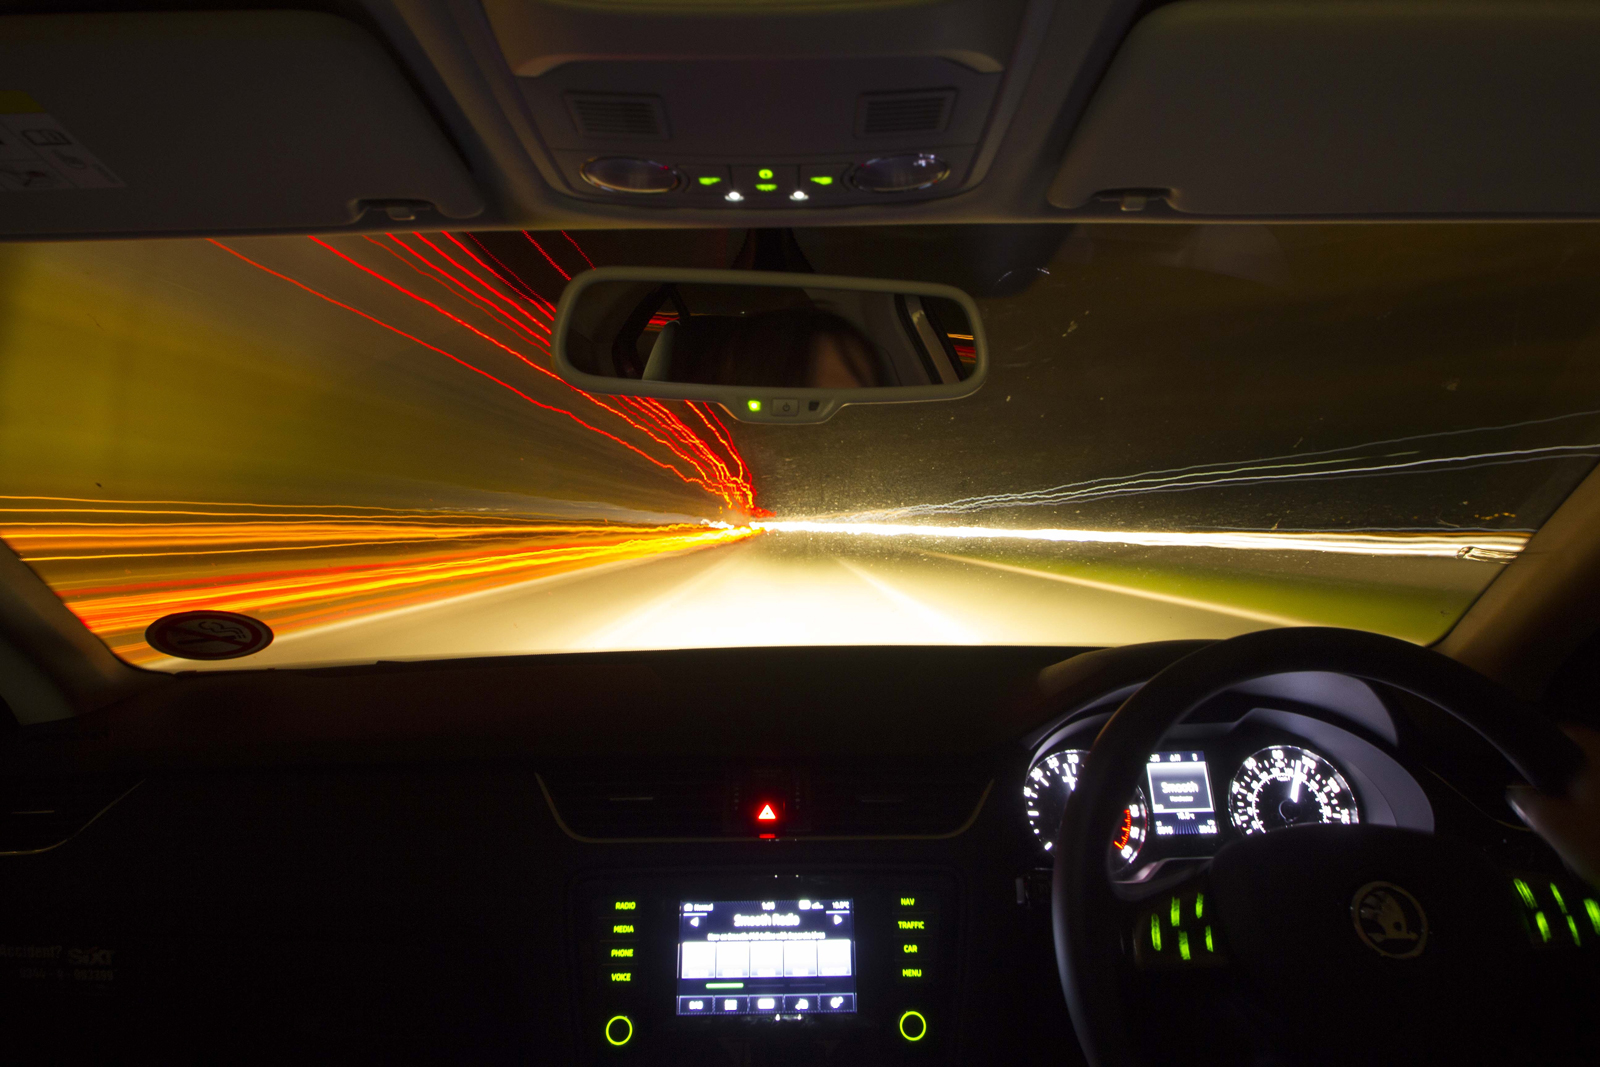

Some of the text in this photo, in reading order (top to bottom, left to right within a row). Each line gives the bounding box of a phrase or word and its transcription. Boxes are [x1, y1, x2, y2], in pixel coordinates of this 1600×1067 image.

[1160, 780, 1199, 794] Smooth
[615, 901, 637, 911] RADIO
[900, 897, 916, 906] NAV
[734, 912, 771, 927] Smooth
[613, 925, 635, 934] MEDIA
[897, 920, 925, 930] TRAFFIC
[610, 949, 634, 958] PHONE
[903, 944, 917, 954] CAR
[611, 972, 632, 982] VOICE
[901, 968, 922, 978] MENU
